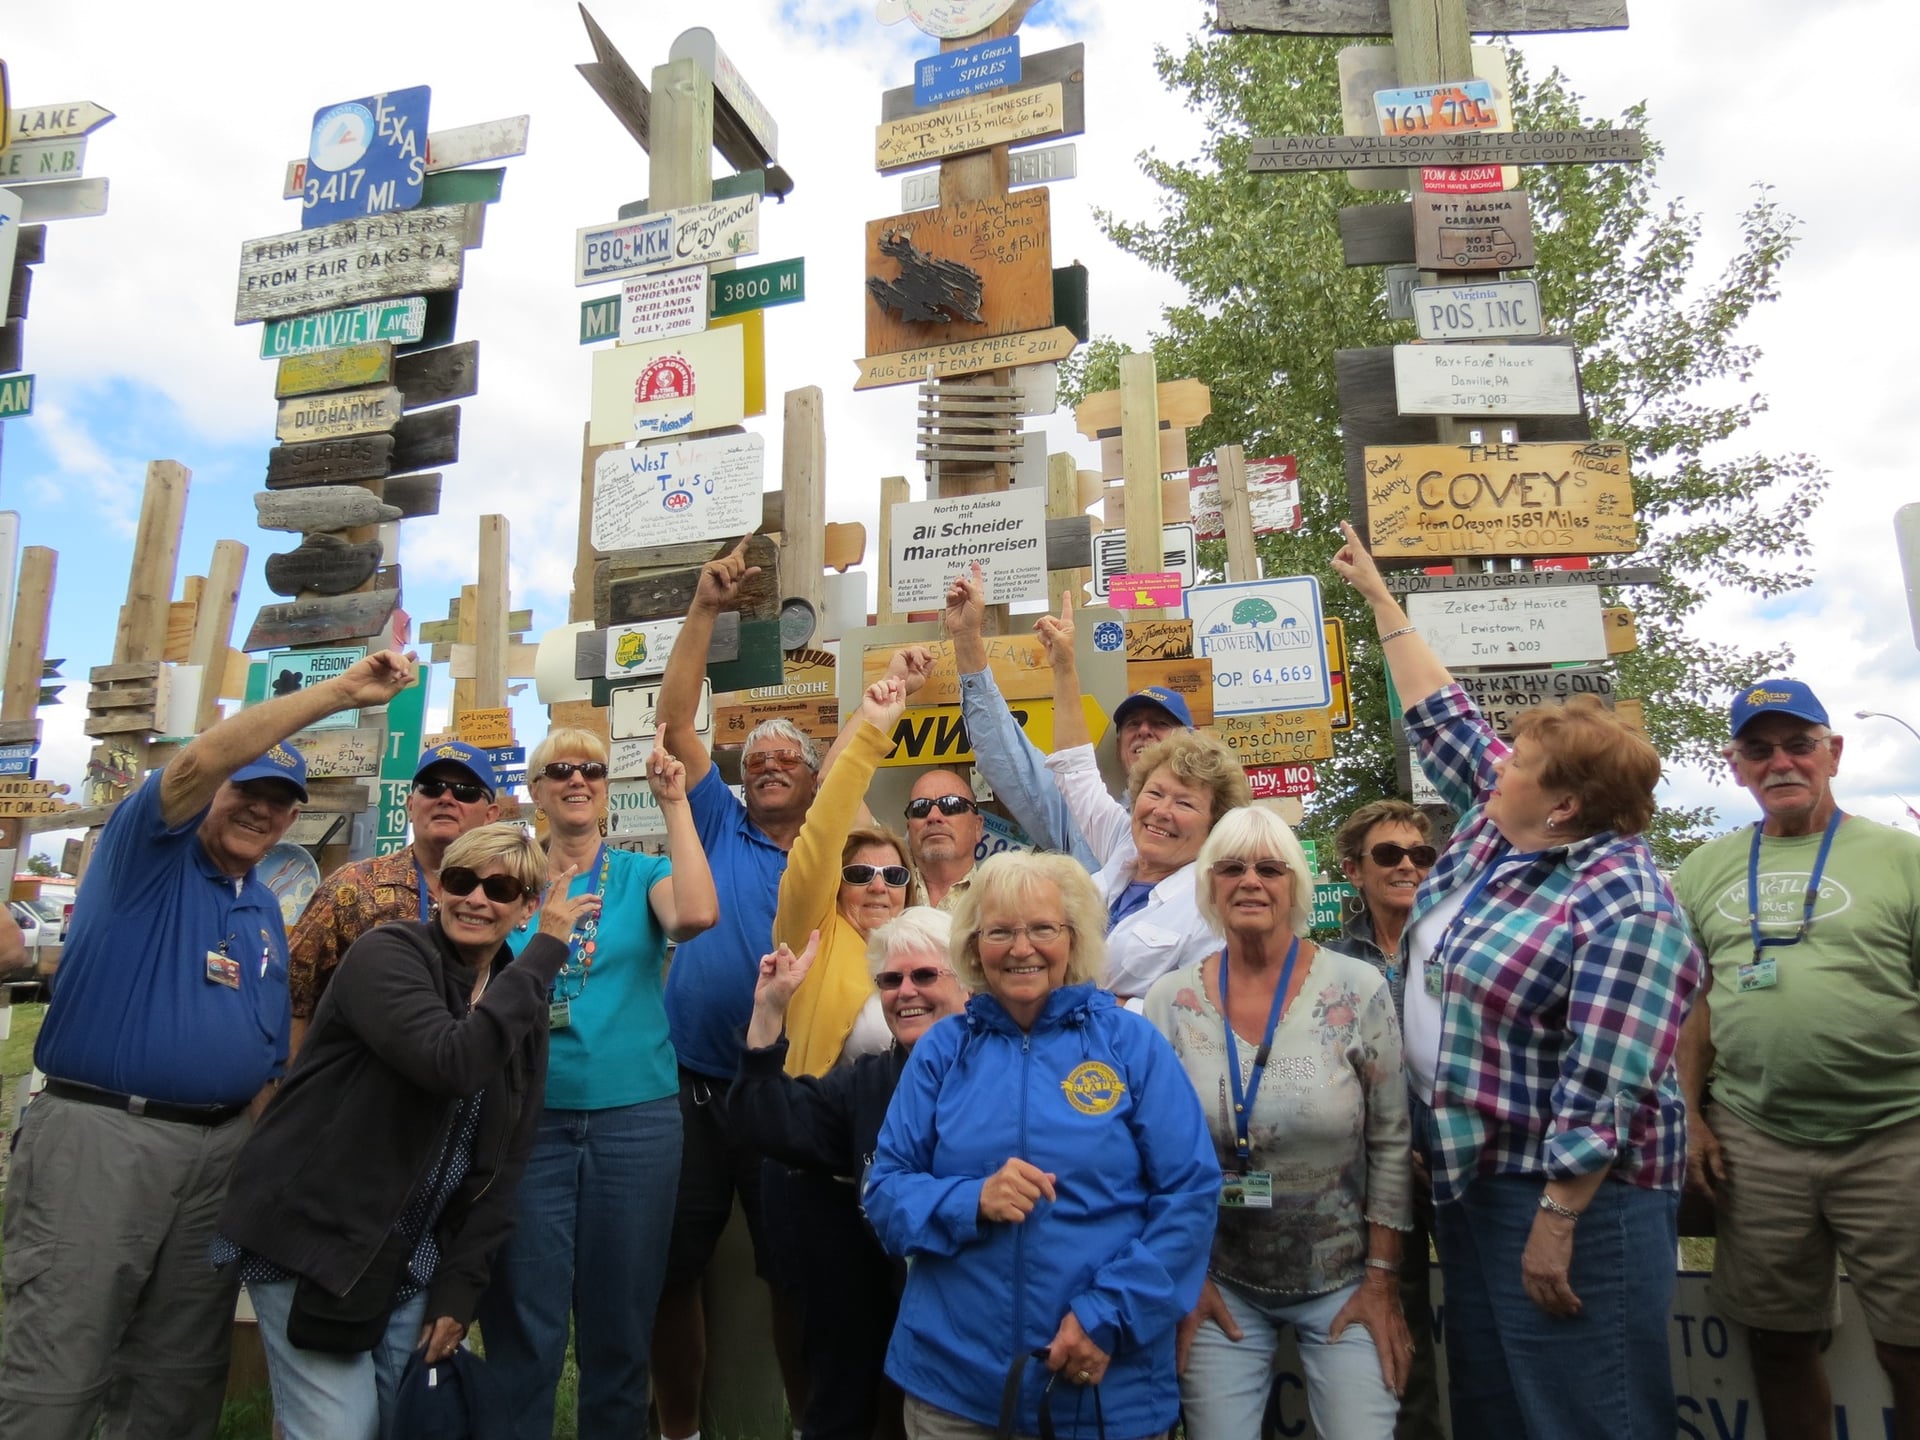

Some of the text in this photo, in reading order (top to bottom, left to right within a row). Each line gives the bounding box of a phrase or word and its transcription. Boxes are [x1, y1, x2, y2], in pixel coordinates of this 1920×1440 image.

[959, 60, 1006, 82] SPIRES
[928, 78, 1004, 103] LAS VEGAS, NEVADA
[1414, 88, 1452, 99] UTAH
[19, 108, 79, 133] LAKE
[940, 121, 980, 138] 3,513
[985, 115, 1014, 129] miles
[1386, 105, 1429, 132] Y61
[374, 93, 425, 186] TEXAS
[1273, 138, 1337, 151] LANCE
[1350, 135, 1435, 149] WILLSON
[1511, 132, 1565, 144] CLOUD
[1571, 131, 1628, 144] MICH.
[39, 150, 81, 173] N.B.
[1259, 153, 1333, 168] MEGAN
[1341, 151, 1435, 165] WILLSON
[1520, 148, 1576, 160] CLOUD
[1584, 146, 1636, 157] MICH.
[1423, 167, 1496, 180] TOM & SUSAN
[304, 169, 400, 213] 3417 MI.
[1425, 182, 1446, 190] SOUTH
[1431, 202, 1513, 212] WIT ALASKA
[993, 215, 1033, 230] Chris
[1445, 215, 1500, 225] CARAVAN
[308, 230, 357, 252] FLAM
[366, 216, 447, 241] FLYERS
[975, 230, 1005, 243] 2010
[1466, 236, 1482, 245] NO
[588, 228, 670, 265] P80 WKW
[970, 232, 1045, 261] Sue Bill
[1466, 244, 1493, 253] 2003
[998, 253, 1022, 264] 2011
[247, 270, 297, 291] FROM
[306, 259, 348, 281] FAIR
[357, 247, 409, 270] OAKS
[625, 273, 703, 294] MONICA & NICK
[724, 273, 797, 302] 3800 MI
[627, 283, 701, 303] SCHOENMANN
[1452, 289, 1498, 301] Virginia
[635, 296, 692, 313] REDLANDS
[632, 305, 695, 324] CALIFORNIA
[1430, 299, 1527, 331] POS INC
[275, 309, 384, 352] GLENVIEW
[665, 318, 691, 331] 2006
[1028, 340, 1057, 353] 2011
[1464, 356, 1494, 368] Faye
[640, 361, 690, 401] TRACKS TO ADVENTURE
[870, 367, 895, 379] AUG
[1496, 375, 1509, 386] PA
[649, 391, 680, 401] TRACKER
[1452, 393, 1507, 405] July 2003
[295, 400, 384, 428] DUCHARME
[1458, 444, 1519, 463] THE
[1571, 450, 1621, 475] Nicole
[1366, 453, 1403, 478] Randy
[668, 494, 688, 508] CAA
[933, 504, 958, 514] North
[972, 500, 1001, 510] Alaska
[958, 511, 973, 519] mit
[1416, 512, 1448, 532] from
[1451, 514, 1502, 534] Oregon
[1507, 512, 1543, 529] 1589
[1545, 510, 1590, 530] Miles
[913, 518, 1024, 540] ali Schneider
[903, 537, 1038, 562] marathonreisen
[1426, 531, 1498, 552] JULY
[1505, 529, 1574, 548] 2003
[947, 560, 966, 569] May
[1568, 571, 1630, 583] MICH.
[1529, 619, 1545, 631] PA
[1100, 633, 1117, 644] 89
[1471, 640, 1541, 656] July 2003
[1252, 665, 1313, 685] 64,669
[751, 681, 829, 698] CHILLICOTHE
[1490, 674, 1611, 695] KATHY GOLD
[1226, 713, 1305, 731] Roy Sue
[501, 752, 515, 760] ST.
[1292, 745, 1316, 760] SC
[1284, 767, 1311, 783] MO
[389, 784, 407, 804] 15
[1287, 784, 1310, 793] 2014
[387, 810, 406, 833] 19
[1762, 897, 1795, 914] DUCK
[1674, 1315, 1729, 1358] TO
